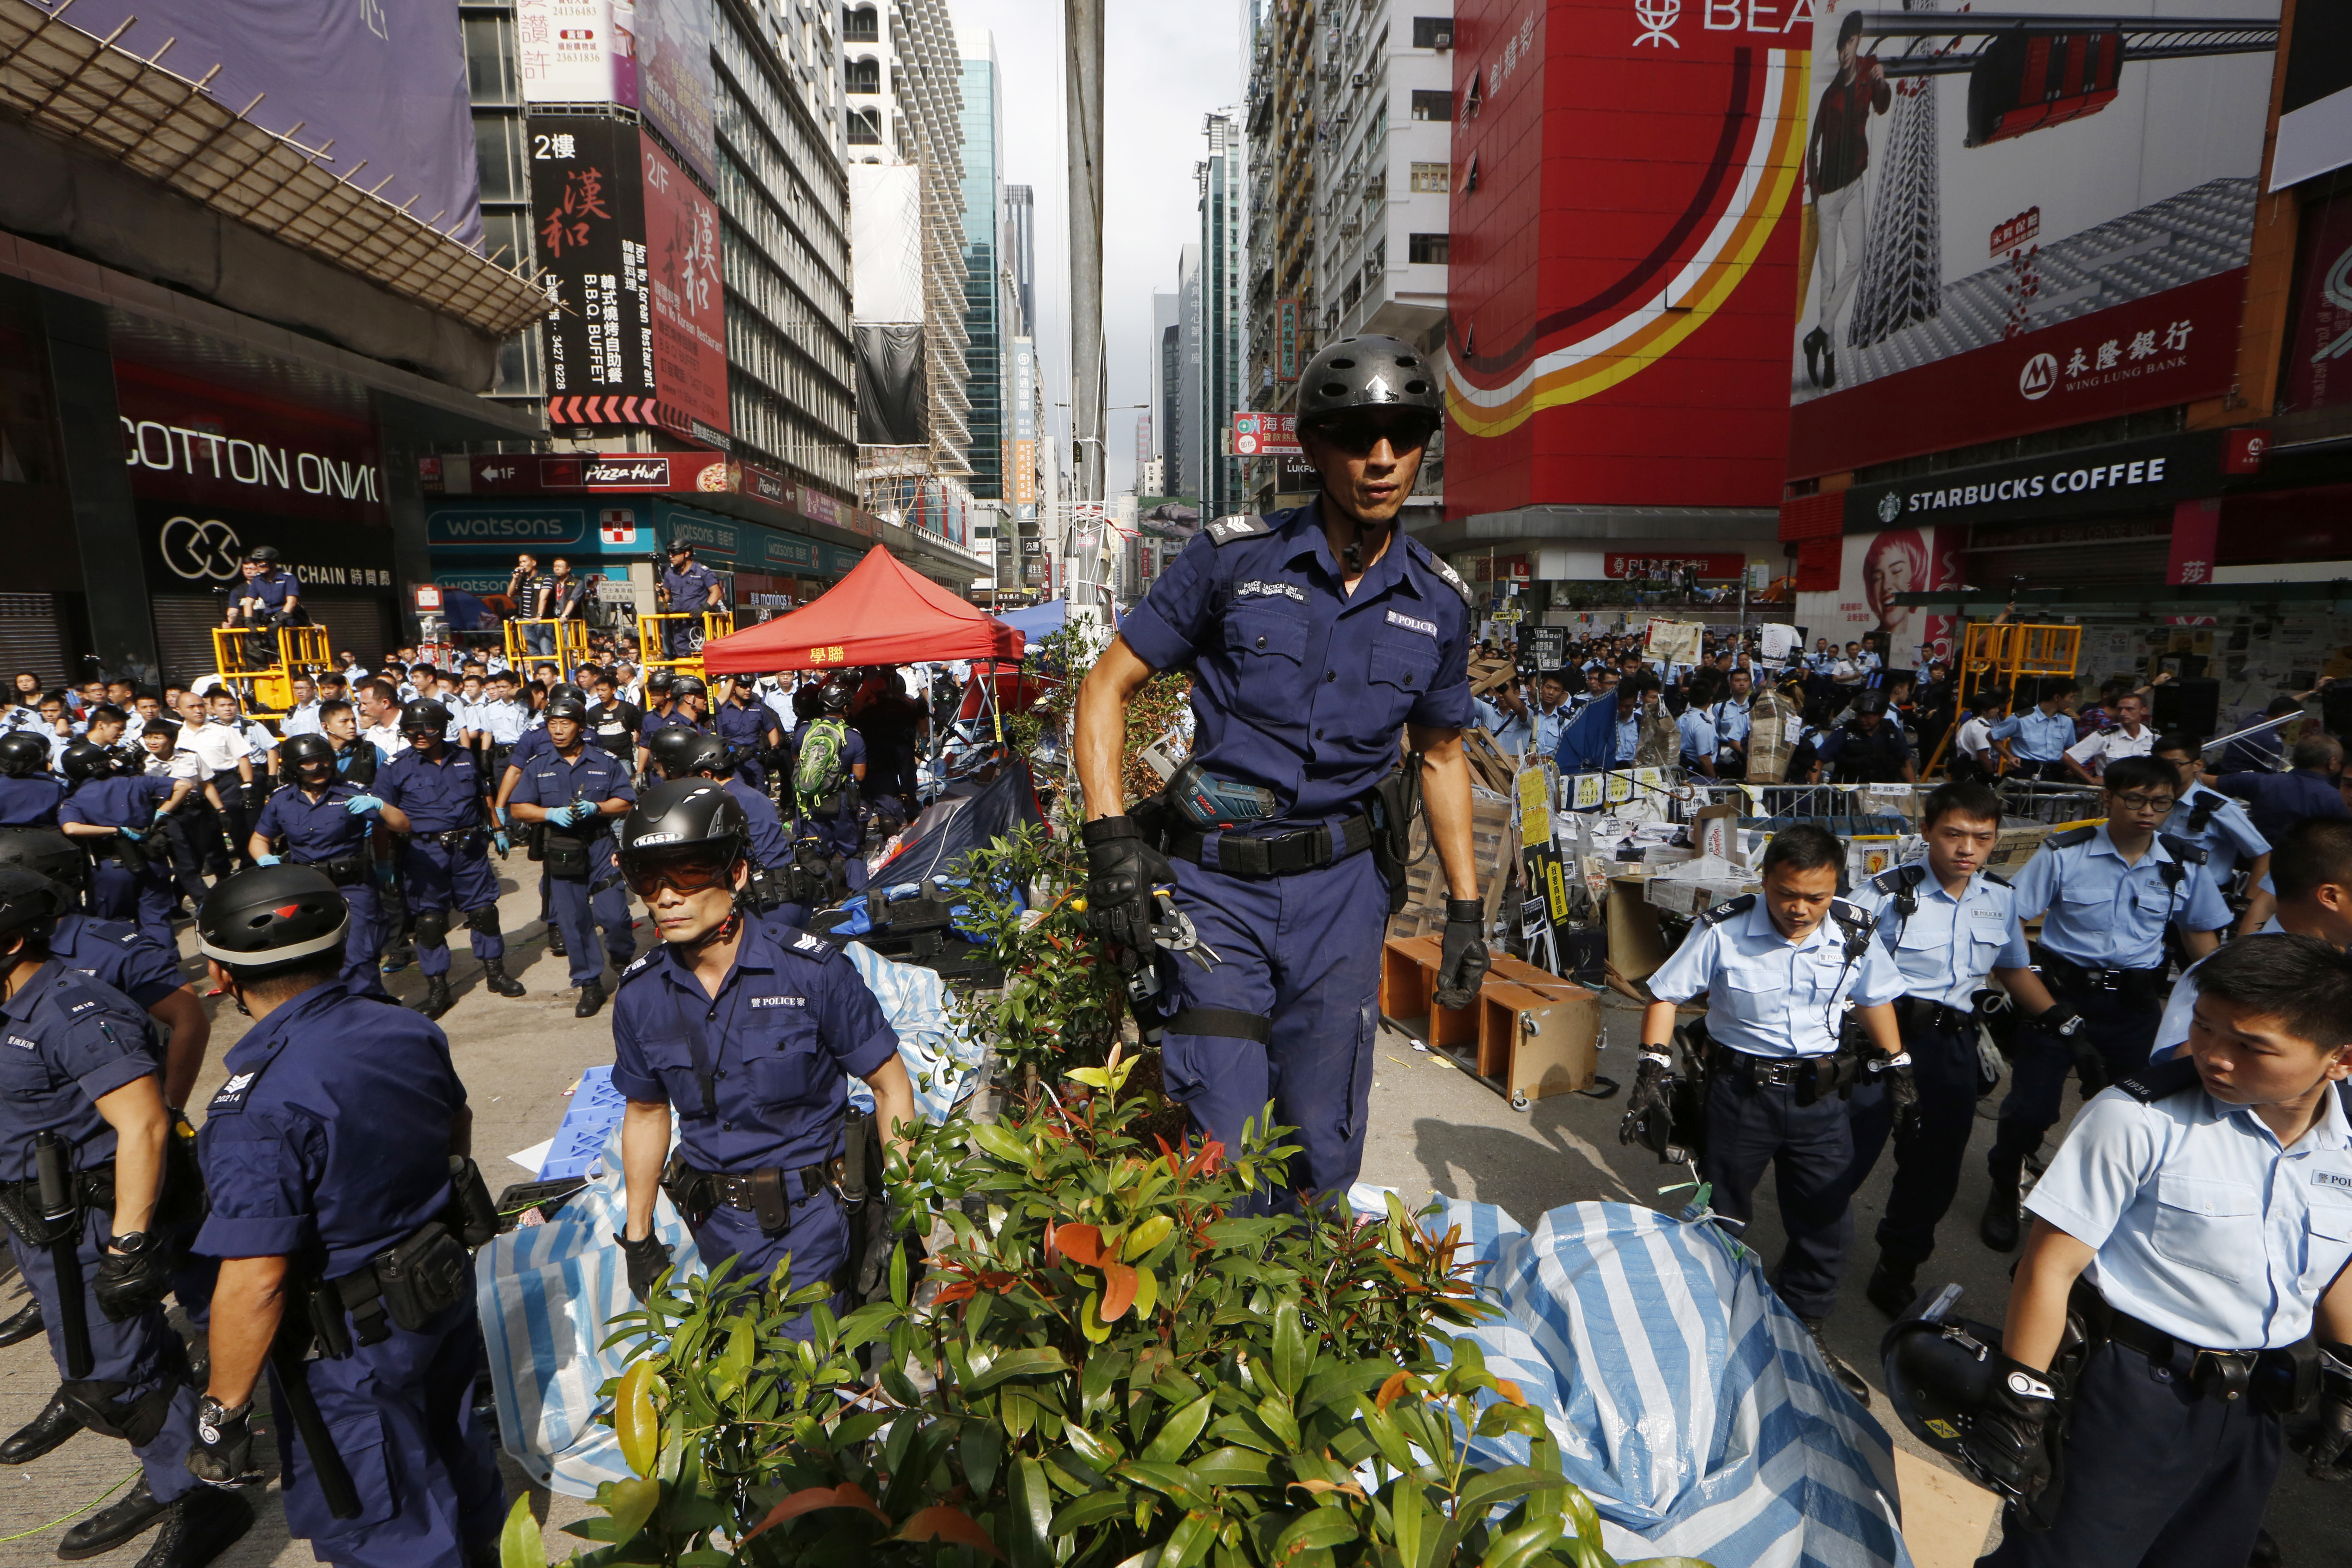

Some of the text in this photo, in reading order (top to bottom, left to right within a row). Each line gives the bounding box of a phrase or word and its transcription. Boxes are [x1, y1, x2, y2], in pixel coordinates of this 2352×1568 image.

[535, 134, 575, 160] 2樓
[647, 152, 669, 193] 2/F
[622, 239, 637, 292] 韓國料理
[635, 243, 655, 388] Hon Wo Korean Restaurant
[1191, 273, 1200, 363] 旺角中心第一座
[584, 274, 605, 385] B.B.Q. BUFFET
[600, 274, 623, 383] 韓式燒烤自助餐
[552, 335, 564, 361] 3427
[2065, 320, 2194, 378] 永隆銀行
[555, 363, 566, 390] 9228
[2066, 356, 2187, 392] WING LUNG BANK
[1018, 366, 1029, 411] 海通國際
[1241, 440, 1254, 448] 即批
[500, 467, 515, 479] 1F
[585, 464, 665, 481] Pizza Hut
[759, 477, 780, 497] Pizza Hut
[1909, 457, 2165, 512] STARBUCKS COFFEE
[446, 517, 563, 535] watsons
[673, 523, 713, 543] watsons
[1212, 523, 1226, 536] 4560
[717, 530, 734, 546] 屈臣氏
[768, 543, 794, 558] watsons
[298, 565, 345, 585] CHAIN
[1027, 564, 1042, 574] 周生生
[2181, 561, 2206, 584] 莎
[1244, 581, 1261, 589] POLICE
[1287, 585, 1298, 593] UNIT
[1285, 590, 1304, 601] SECTION
[760, 590, 787, 609] mannings
[1388, 610, 1397, 623] 警
[1398, 615, 1434, 633] POLICE
[810, 646, 844, 664] 學聯
[1197, 795, 1217, 815] BOSCH
[638, 833, 676, 846] KASK
[1551, 866, 1563, 915] 我要真普選
[1875, 878, 1889, 892] 10837
[72, 1001, 95, 1012] 8616
[751, 997, 806, 1008] 警 POLICE 察
[2124, 1079, 2152, 1095] 11936
[214, 1094, 241, 1103] 20214
[2318, 1173, 2328, 1183] 警
